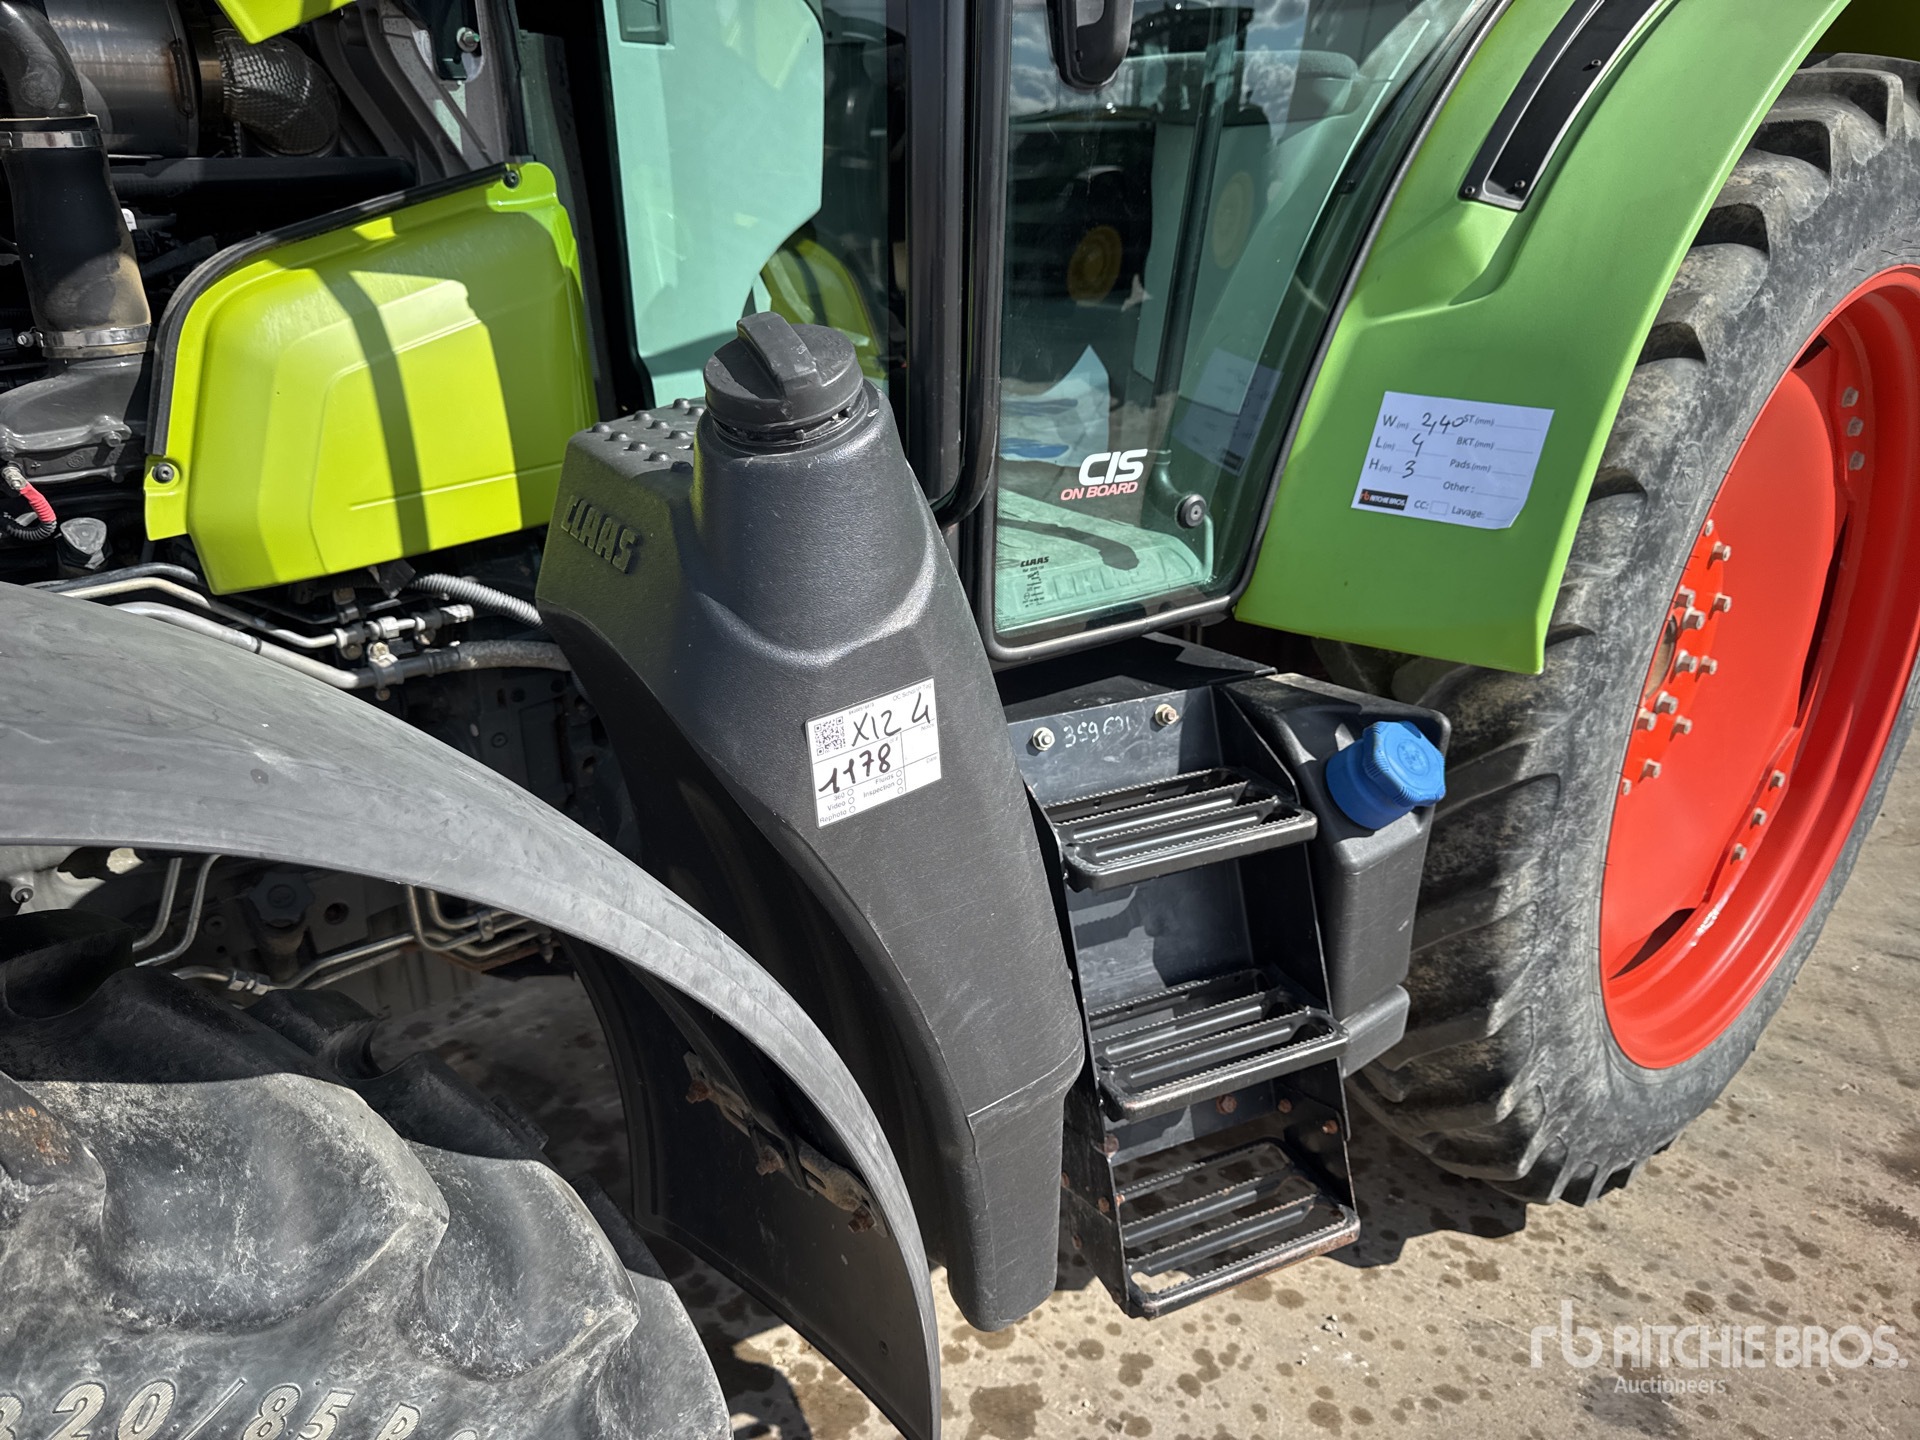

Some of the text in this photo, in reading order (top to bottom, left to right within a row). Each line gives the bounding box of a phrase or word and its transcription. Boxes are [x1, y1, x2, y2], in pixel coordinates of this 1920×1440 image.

[1078, 449, 1148, 486] CIS
[1402, 460, 1416, 478] 3
[1060, 482, 1138, 500] ON BOARD
[560, 494, 639, 573] CLAAS
[1020, 556, 1050, 567] CLAAS
[863, 782, 896, 798] Inspection
[827, 800, 846, 811] Video
[819, 809, 847, 824] Rephoto
